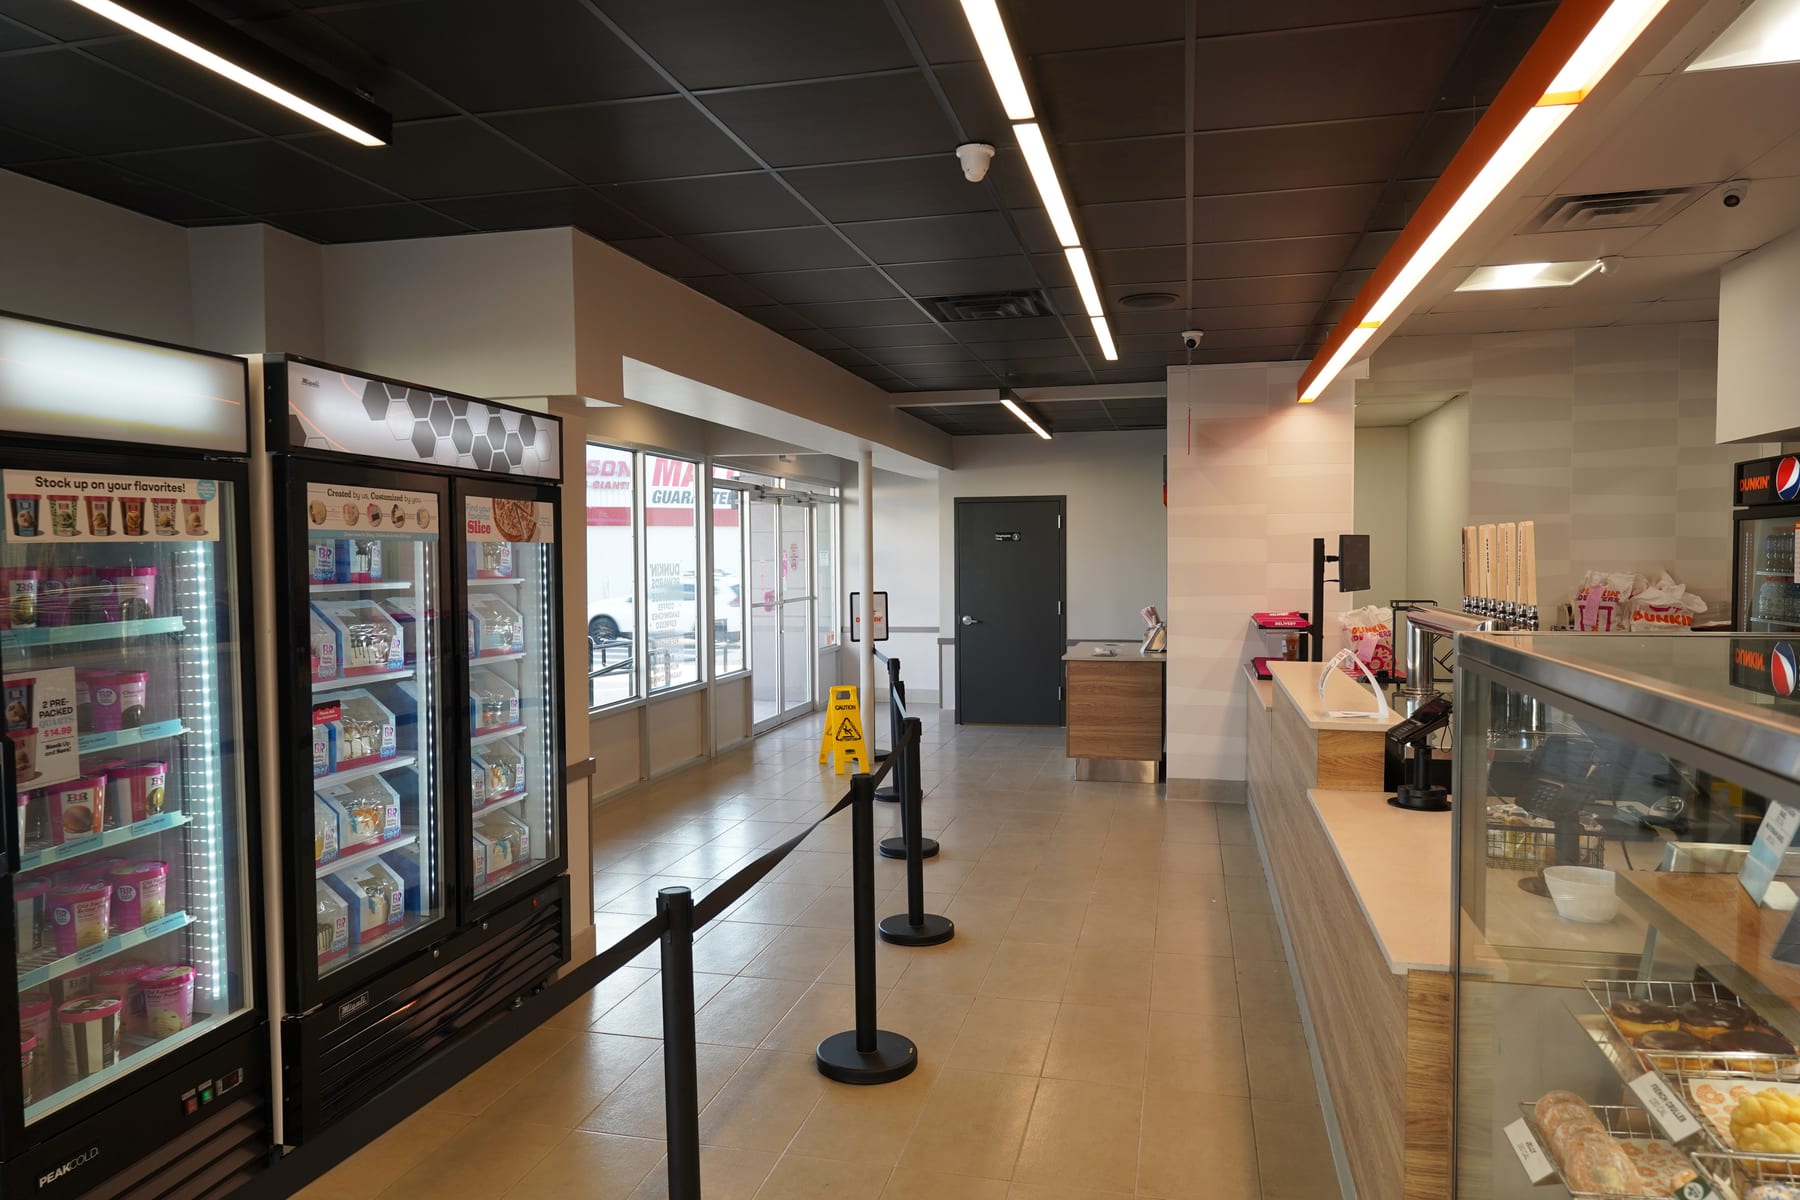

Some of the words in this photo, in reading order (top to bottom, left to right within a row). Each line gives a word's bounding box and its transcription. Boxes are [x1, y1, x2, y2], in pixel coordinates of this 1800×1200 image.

[35, 476, 71, 488] Stock
[74, 480, 88, 491] up
[91, 481, 105, 489] on
[107, 482, 132, 492] your
[134, 481, 186, 492] flavorites!
[1739, 475, 1770, 492] DUNKIN'
[327, 489, 352, 499] Created
[370, 492, 404, 502] Customized
[467, 520, 492, 534] Slice
[42, 700, 49, 709] 2
[50, 698, 70, 707] PRE-
[38, 706, 74, 718] PACKED
[40, 1147, 99, 1188] PEAKCOLD
